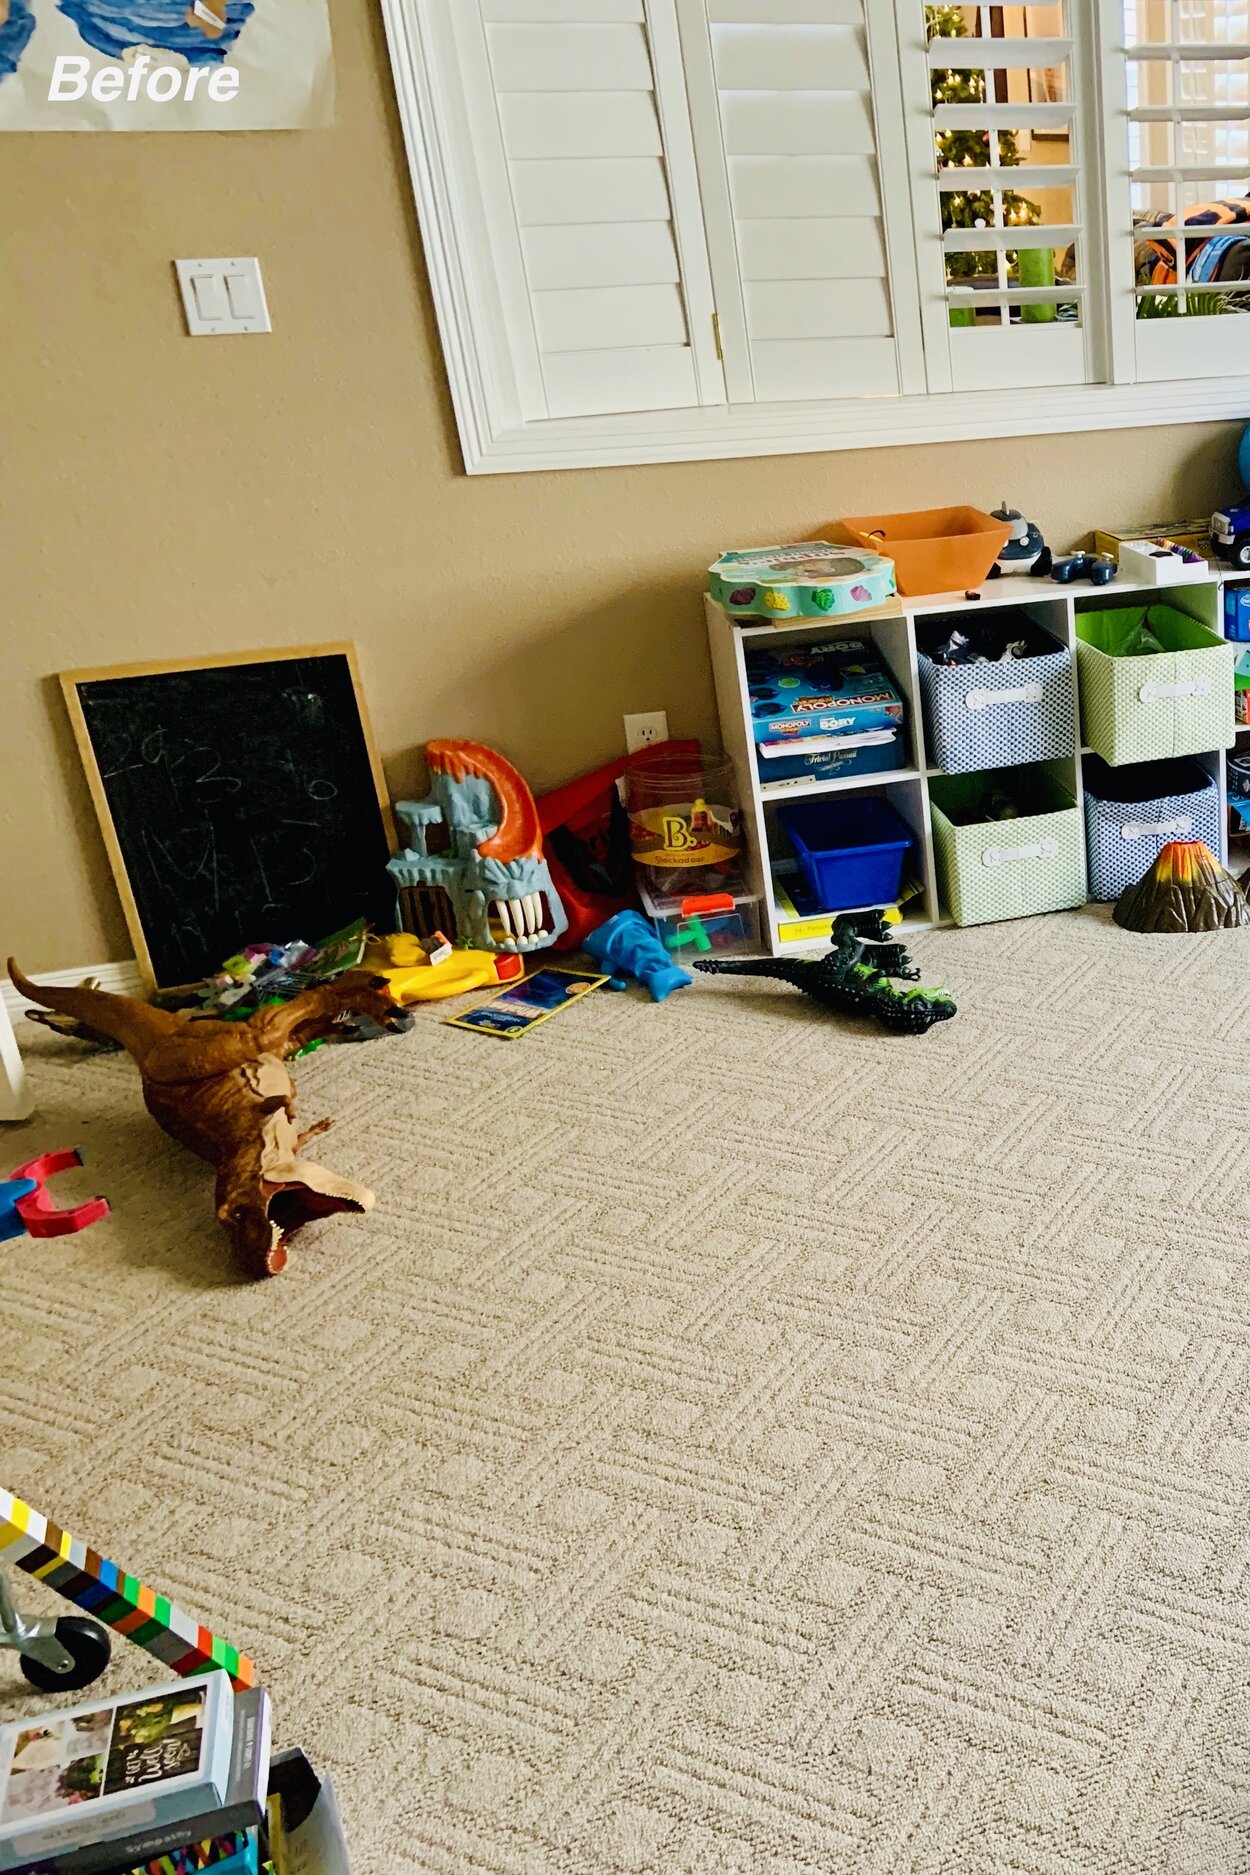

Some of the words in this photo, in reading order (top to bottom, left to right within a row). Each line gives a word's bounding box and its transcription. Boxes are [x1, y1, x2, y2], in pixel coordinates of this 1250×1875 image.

[796, 693, 890, 713] MONOPOLY
[771, 720, 810, 730] MONOPOLY
[820, 717, 856, 730] DORY
